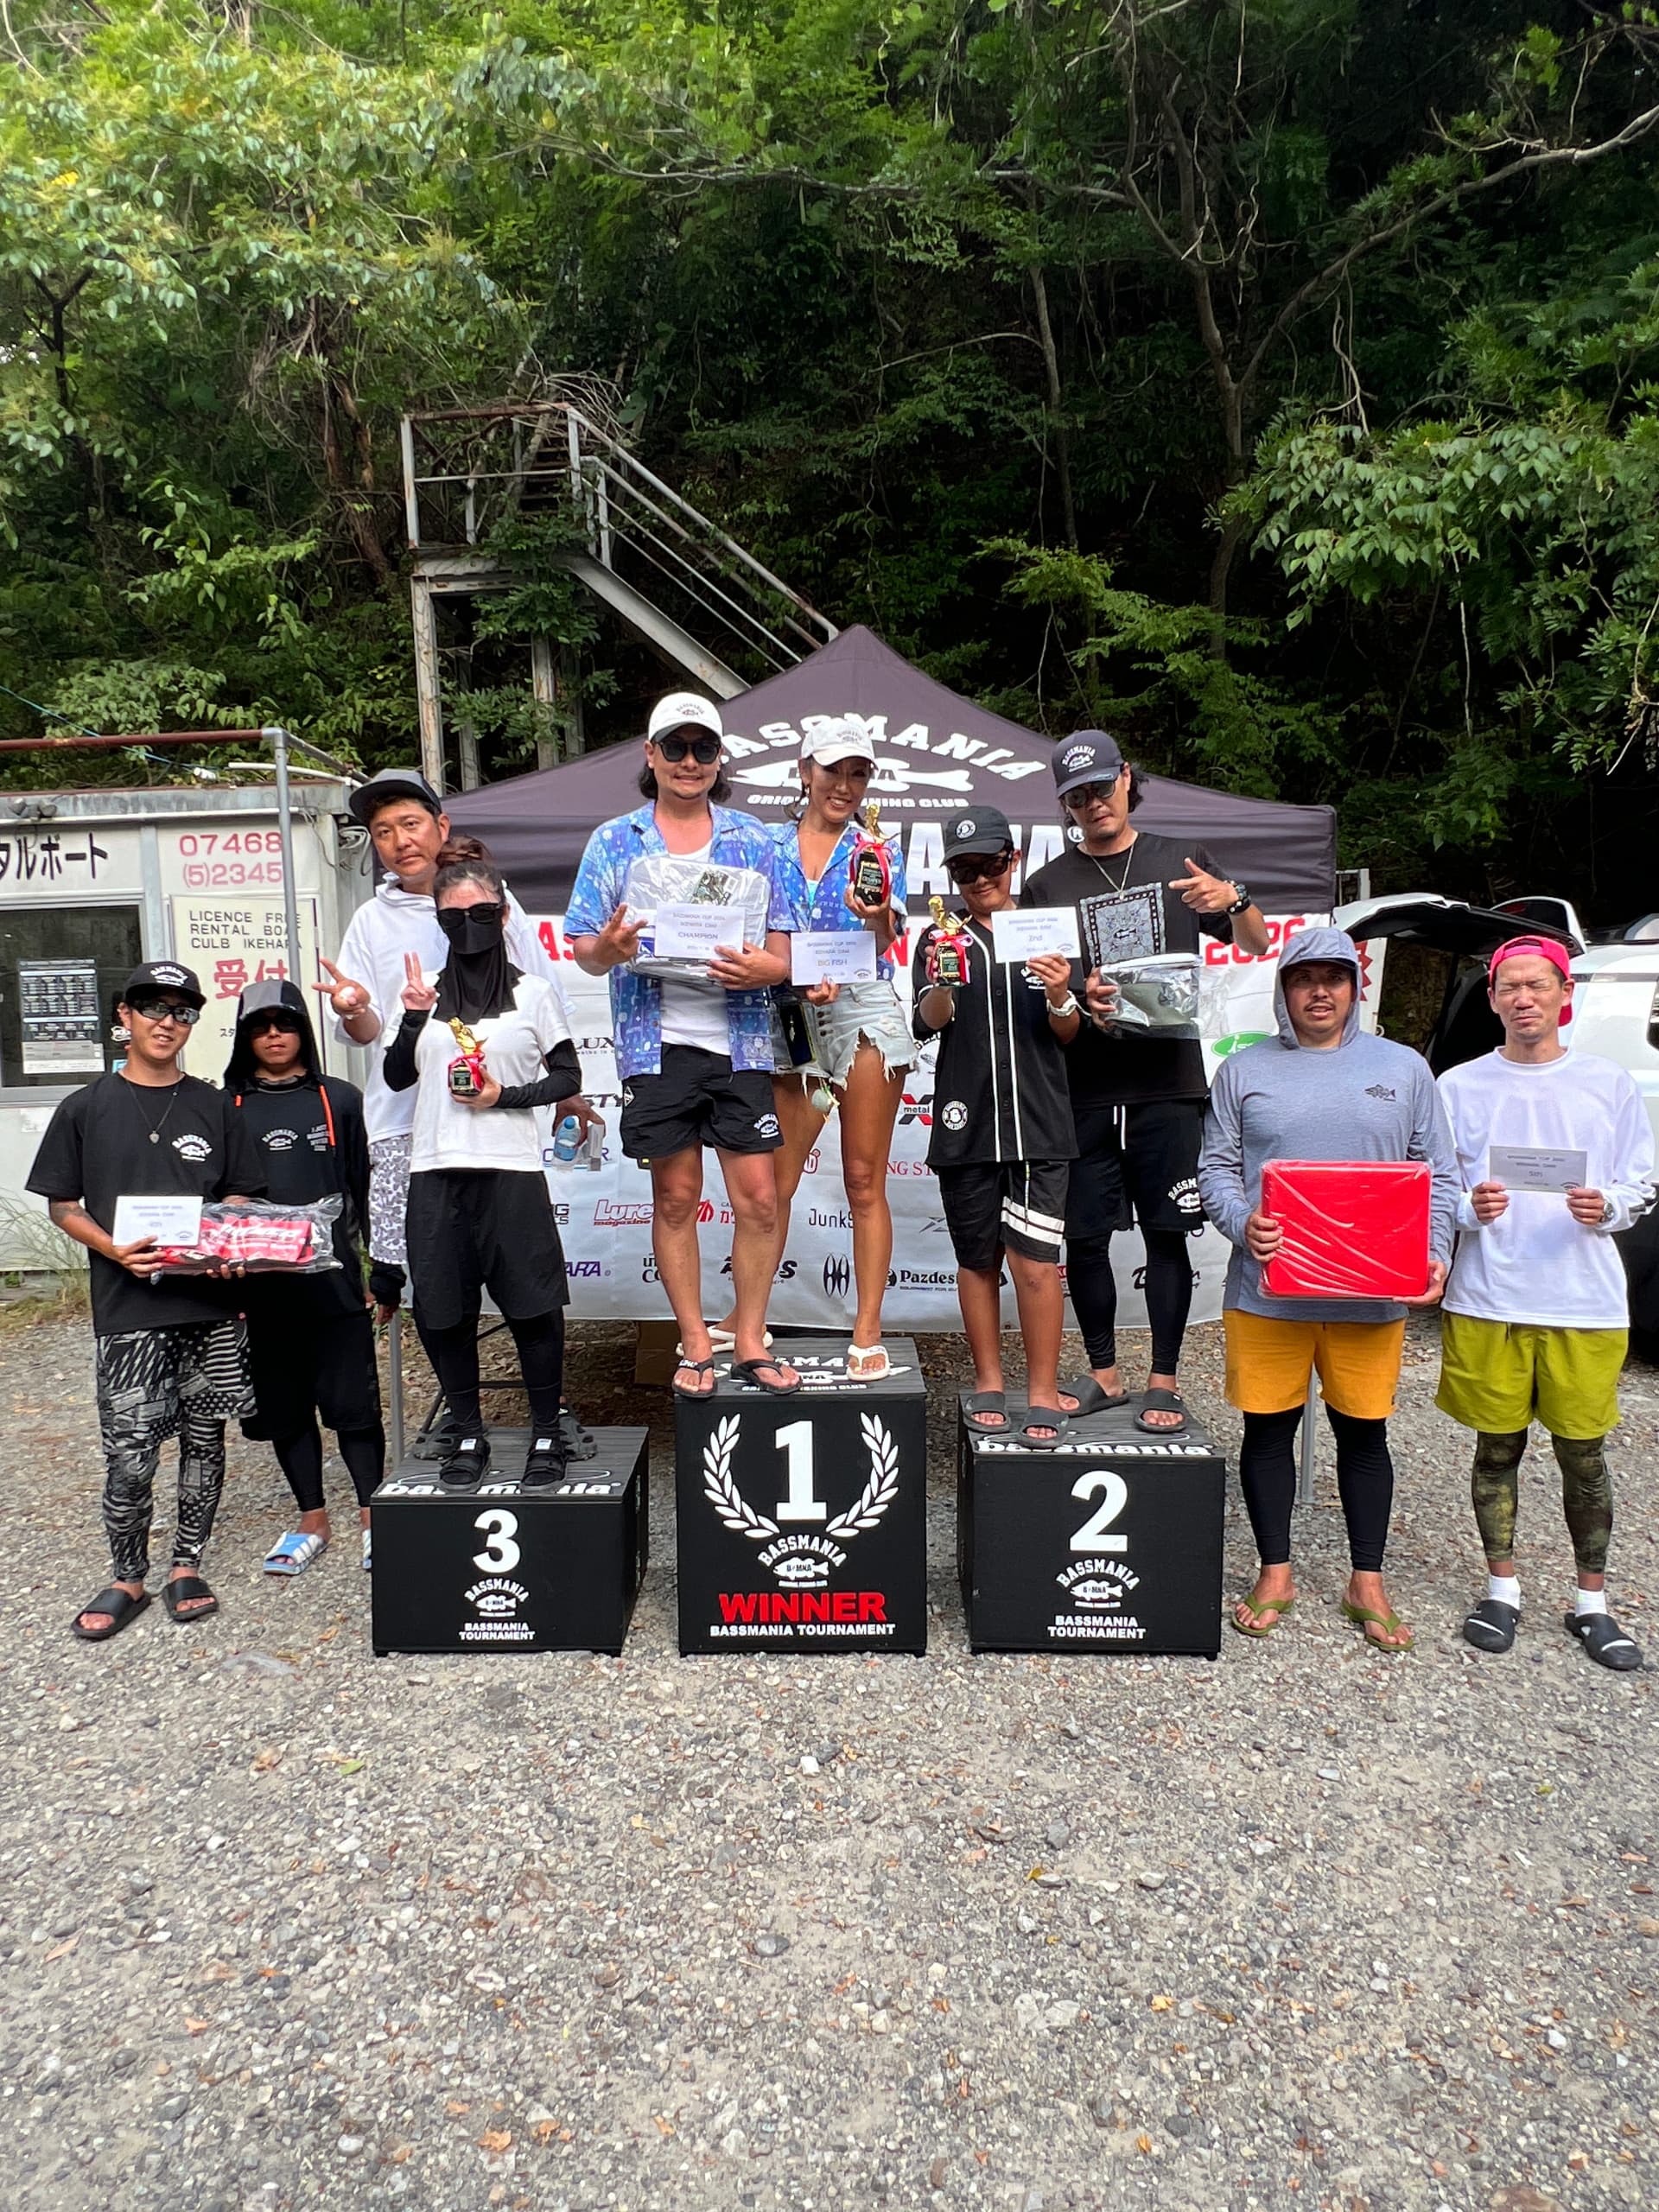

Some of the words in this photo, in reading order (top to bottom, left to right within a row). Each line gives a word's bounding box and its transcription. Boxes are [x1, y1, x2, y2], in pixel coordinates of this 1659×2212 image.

[918, 798, 969, 808] CLUB
[179, 831, 283, 856] 07468
[182, 861, 283, 888] (5)2345
[188, 910, 252, 923] LICENCE
[265, 912, 302, 924] FRE
[190, 924, 250, 936] RENTAL
[191, 938, 231, 949] CULB
[594, 1199, 654, 1221] Lure
[899, 1270, 958, 1285] Pazdes
[775, 1420, 827, 1521] 1
[1070, 1470, 1128, 1552] 2
[473, 1509, 521, 1573] 3
[757, 1534, 848, 1567] BASSMANIA
[1055, 1558, 1141, 1590] BASSMANIA
[464, 1578, 530, 1602] BASSMANIA
[718, 1592, 887, 1623] WINNER
[464, 1623, 529, 1631] BASSMANIA
[1054, 1615, 1138, 1627] BASSMANIA
[459, 1630, 536, 1641] TOURNAMENT
[709, 1624, 794, 1637] BASSMANIA
[797, 1624, 896, 1637] TOURNAMENT
[1047, 1626, 1147, 1639] TOURNAMENT
